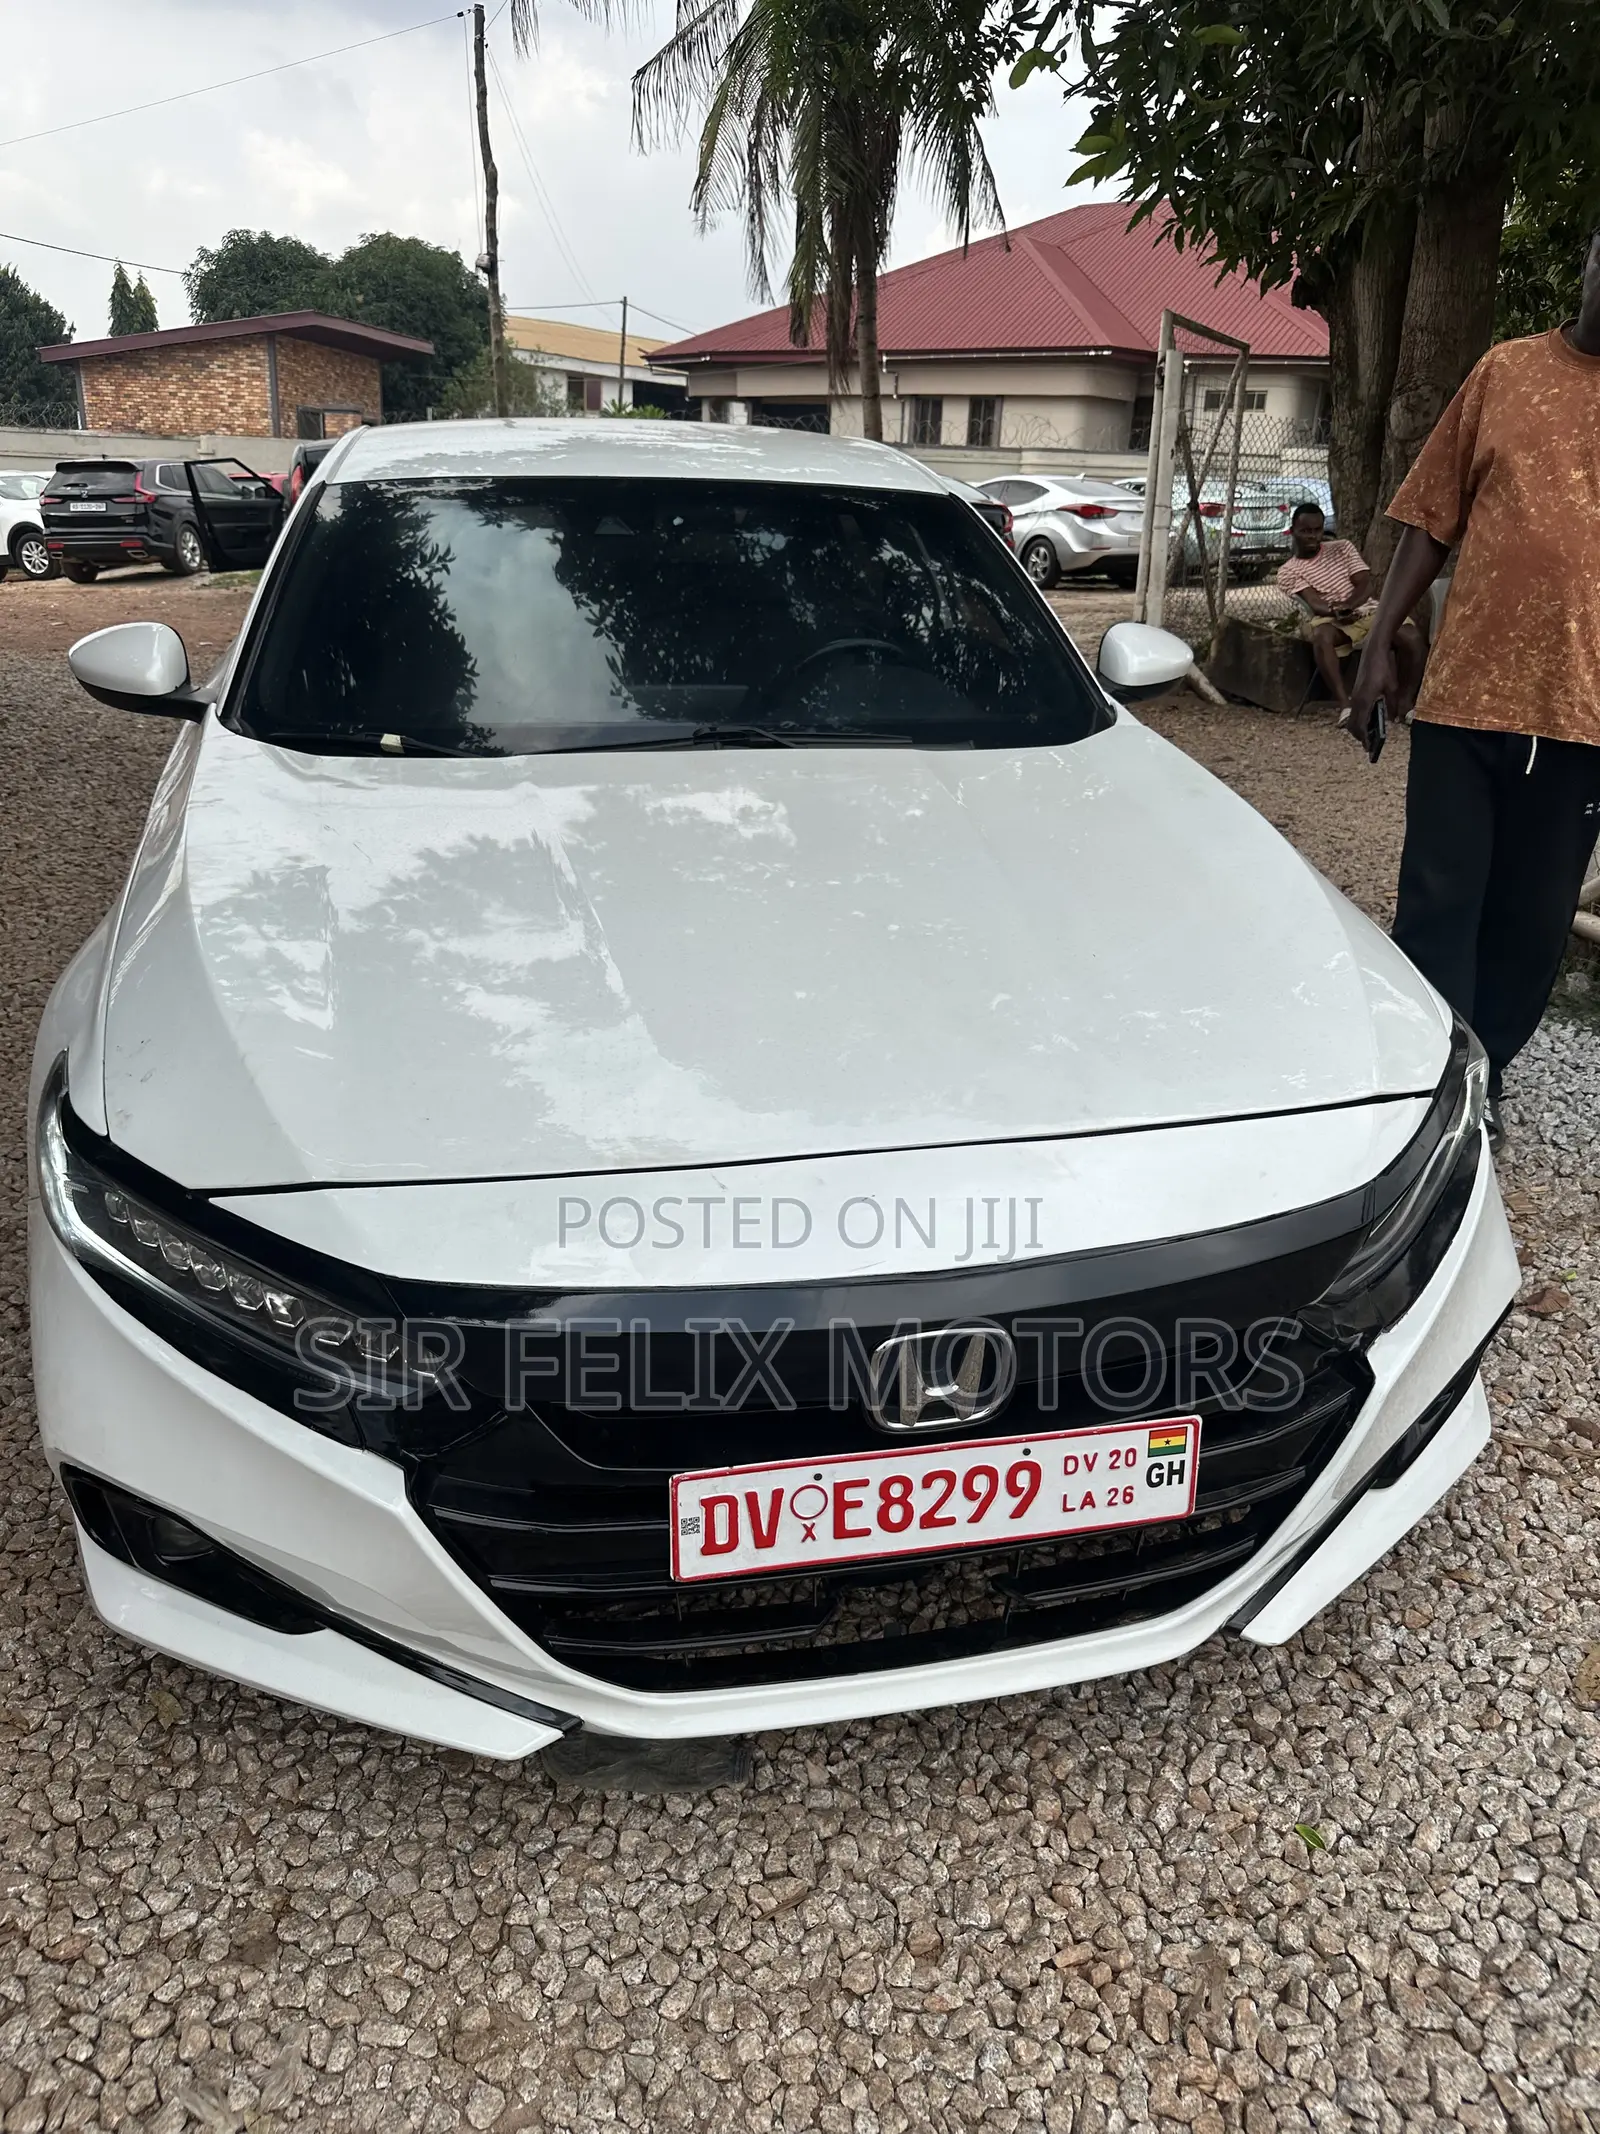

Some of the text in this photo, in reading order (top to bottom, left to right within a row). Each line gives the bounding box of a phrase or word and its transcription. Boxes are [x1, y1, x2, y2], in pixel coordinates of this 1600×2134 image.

[1063, 1447, 1138, 1476] DV 20
[1145, 1460, 1186, 1488] GH
[700, 1460, 1043, 1556] DV E8299
[1061, 1485, 1135, 1513] LA 26
